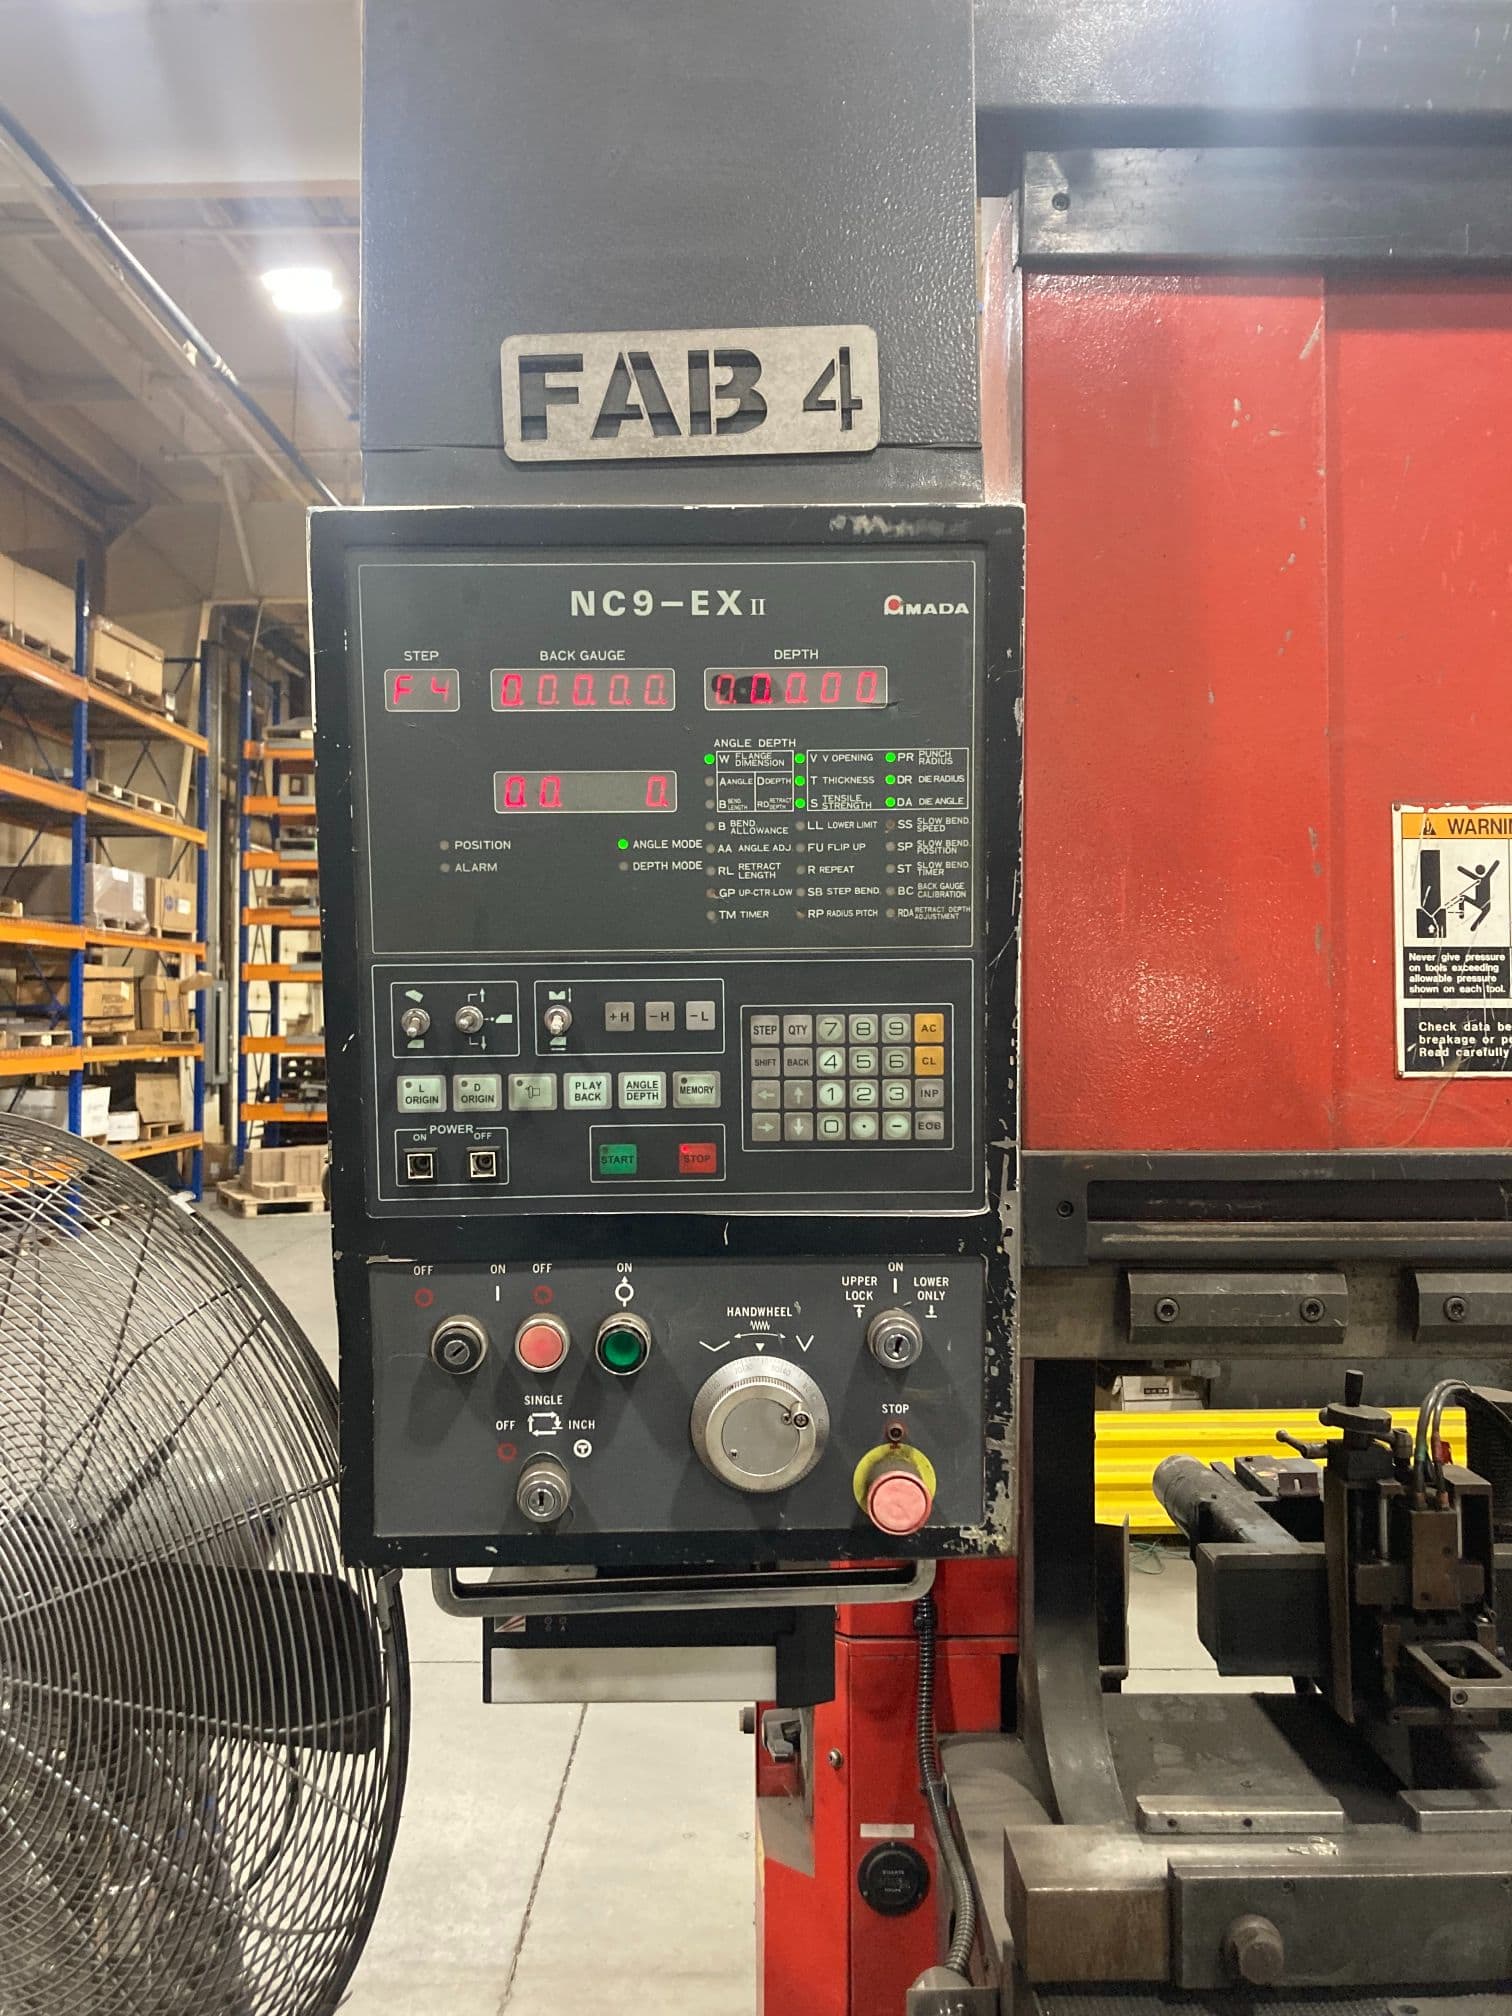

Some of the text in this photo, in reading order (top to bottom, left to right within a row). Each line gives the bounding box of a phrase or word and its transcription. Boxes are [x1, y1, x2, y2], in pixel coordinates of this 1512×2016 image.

[518, 345, 863, 442] FAB 4
[883, 595, 970, 616] AMADA
[403, 650, 440, 661] STEP
[539, 650, 626, 661] BACK GAUGE
[773, 649, 819, 660] DEPTH
[713, 738, 797, 748] ANGLE DEPTH
[718, 754, 730, 764] W
[735, 752, 772, 760] FLANGE
[809, 753, 874, 763] V OPENING
[897, 752, 914, 762] PR
[918, 750, 952, 758] PUNCH
[735, 759, 785, 767] DIMENSION
[918, 757, 954, 765] RADIUS
[810, 775, 875, 785] T THICKNESS
[897, 774, 965, 784] DR DIE RADIUS
[810, 798, 819, 808] S
[822, 794, 862, 802] TENSILE
[897, 796, 965, 807] DA DIE ANGLE
[822, 801, 873, 809] STRENGTH
[730, 819, 756, 827] BEND
[807, 820, 878, 830] LL LOWER LIMIT
[897, 819, 913, 829] SS
[917, 816, 970, 825] SLOW BEND
[718, 821, 726, 831] B
[730, 826, 789, 835] ALLOWANCE
[917, 824, 946, 833] SPEED
[1447, 818, 1512, 835] WARNI
[454, 840, 512, 850] POSITION
[633, 839, 703, 849] ANGLE MODE
[717, 843, 792, 853] AA ANGLE ADJ
[807, 842, 866, 853] FU FLIP UP
[897, 841, 914, 852] SP
[917, 839, 969, 847] SLOW BEND
[917, 846, 958, 855] POSITION
[454, 862, 498, 872] ALARM
[632, 861, 703, 871] DEPTH MODE
[738, 862, 782, 871] RETRACT
[897, 863, 913, 874] ST
[917, 860, 970, 869] SLOW BEND
[717, 866, 735, 876] RL
[738, 870, 776, 880] LENGTH
[807, 865, 855, 875] R REPEAT
[917, 868, 945, 876] TIMER
[897, 886, 914, 896] BC
[917, 882, 966, 890] BACK GAUGE
[719, 888, 736, 898] GP
[807, 886, 880, 897] SB STEP BEND
[917, 890, 967, 898] CALIBRATION
[718, 910, 770, 920] TM TIMER
[807, 909, 879, 919] RP RADIUS PITCH
[897, 907, 914, 918] RDA
[1408, 952, 1506, 963] Never give pressure
[1408, 963, 1499, 974] on tools exceeding
[1409, 973, 1497, 984] allowable pressure
[1409, 984, 1506, 993] shown on each tool.
[752, 1025, 778, 1036] STEP
[787, 1024, 808, 1037] QTY
[823, 1021, 838, 1037] 7
[855, 1021, 871, 1036] 8
[888, 1021, 904, 1036] 9
[920, 1023, 937, 1033] AC
[1418, 1021, 1491, 1032] Check data
[1418, 1034, 1496, 1046] breakage or
[1419, 1046, 1510, 1059] Read carefully
[753, 1058, 777, 1067] SHIFT
[786, 1058, 810, 1067] BACK
[823, 1054, 838, 1069] 4
[855, 1054, 871, 1069] 5
[888, 1054, 904, 1069] 6
[921, 1056, 936, 1066] CL
[418, 1084, 425, 1094] L
[474, 1083, 481, 1093] D
[574, 1080, 602, 1091] PLAY
[625, 1080, 659, 1090] ANGLE
[679, 1084, 715, 1096] MEMORY
[574, 1092, 602, 1102] BACK
[625, 1091, 660, 1102] DEPTH
[826, 1086, 835, 1101] 1
[855, 1086, 872, 1101] 2
[888, 1086, 905, 1101] 3
[919, 1088, 939, 1098] INP
[404, 1095, 440, 1106] ORIGIN
[460, 1094, 495, 1105] ORIGIN
[429, 1123, 474, 1135] POWER
[412, 1132, 427, 1142] ON
[473, 1131, 492, 1141] OFF
[600, 1154, 634, 1165] START
[683, 1153, 712, 1165] STOP
[412, 1265, 434, 1276] OFF
[490, 1264, 506, 1275] ON
[532, 1263, 552, 1274] OFF
[616, 1262, 632, 1273] ON
[887, 1262, 904, 1272] ON
[841, 1275, 878, 1287] UPPER
[913, 1276, 950, 1287] LOWER
[845, 1290, 874, 1301] LOCK
[917, 1290, 946, 1301] ONLY
[726, 1306, 793, 1317] HANDWHEEL
[523, 1394, 563, 1406] SINGLE
[881, 1403, 910, 1415] STOP
[495, 1420, 516, 1431] OFF
[568, 1419, 596, 1430] INCH
